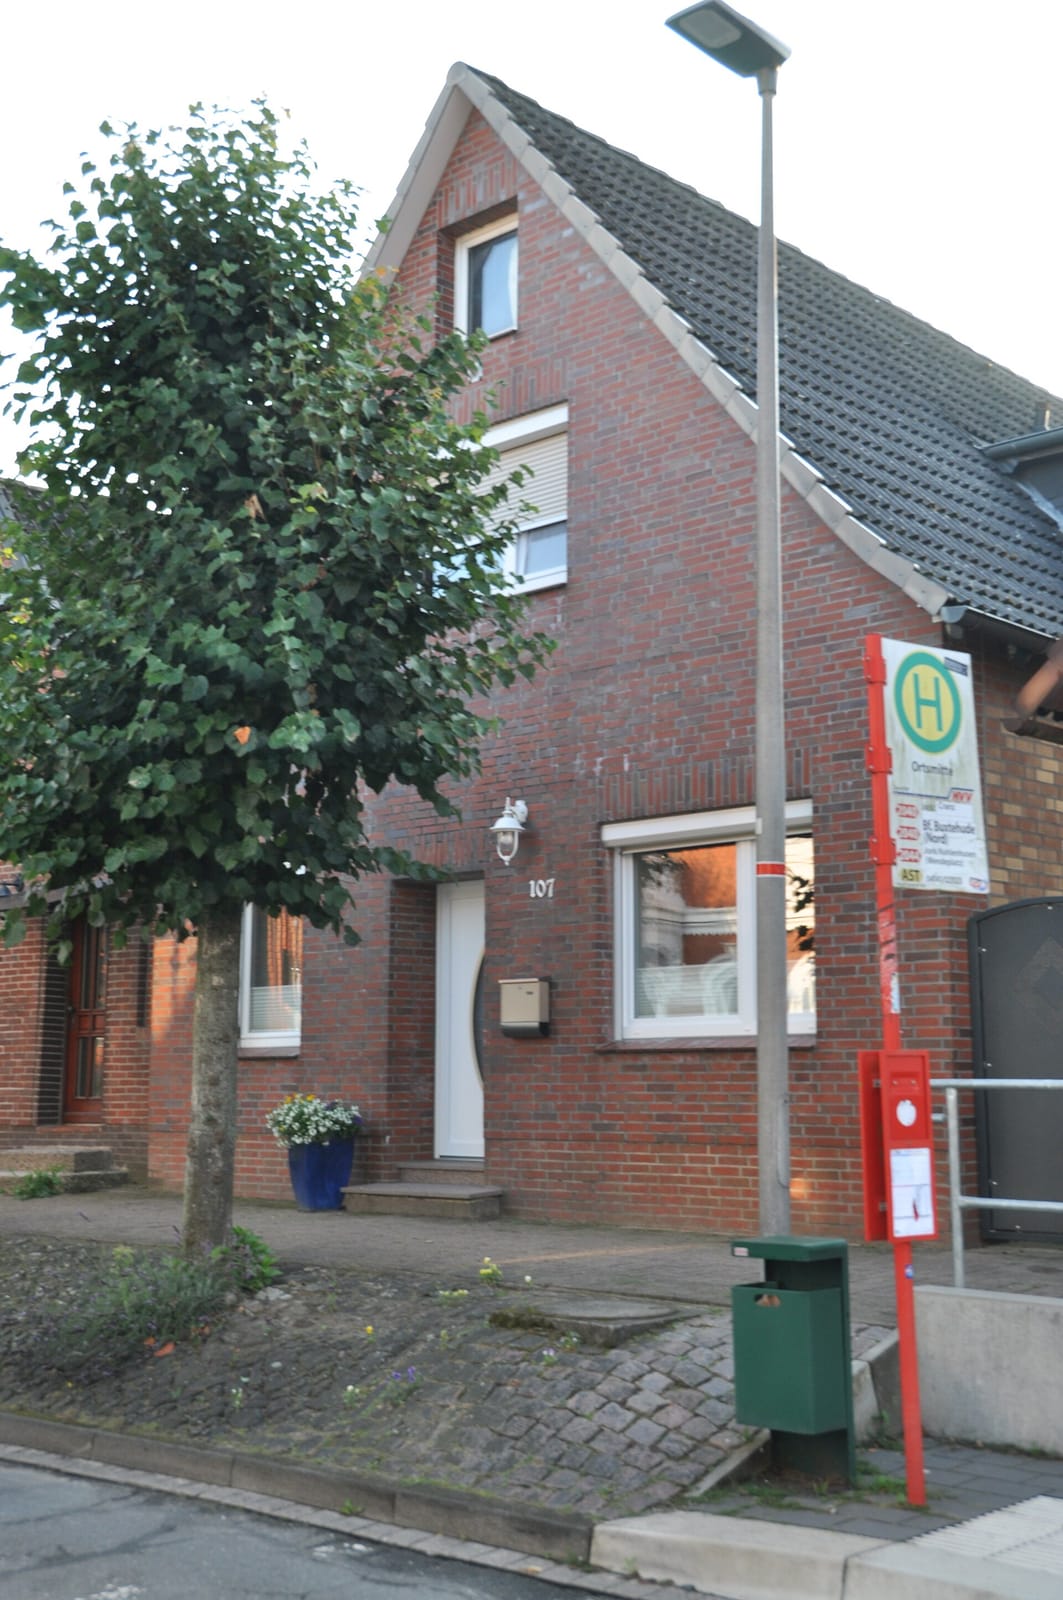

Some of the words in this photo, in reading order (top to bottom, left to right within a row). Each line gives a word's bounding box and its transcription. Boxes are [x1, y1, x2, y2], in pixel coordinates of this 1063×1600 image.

[913, 672, 943, 732] H
[911, 760, 954, 777] Ortsmitte
[934, 820, 975, 835] Buxtehude
[902, 868, 921, 881] AST
[528, 877, 556, 898] 107
